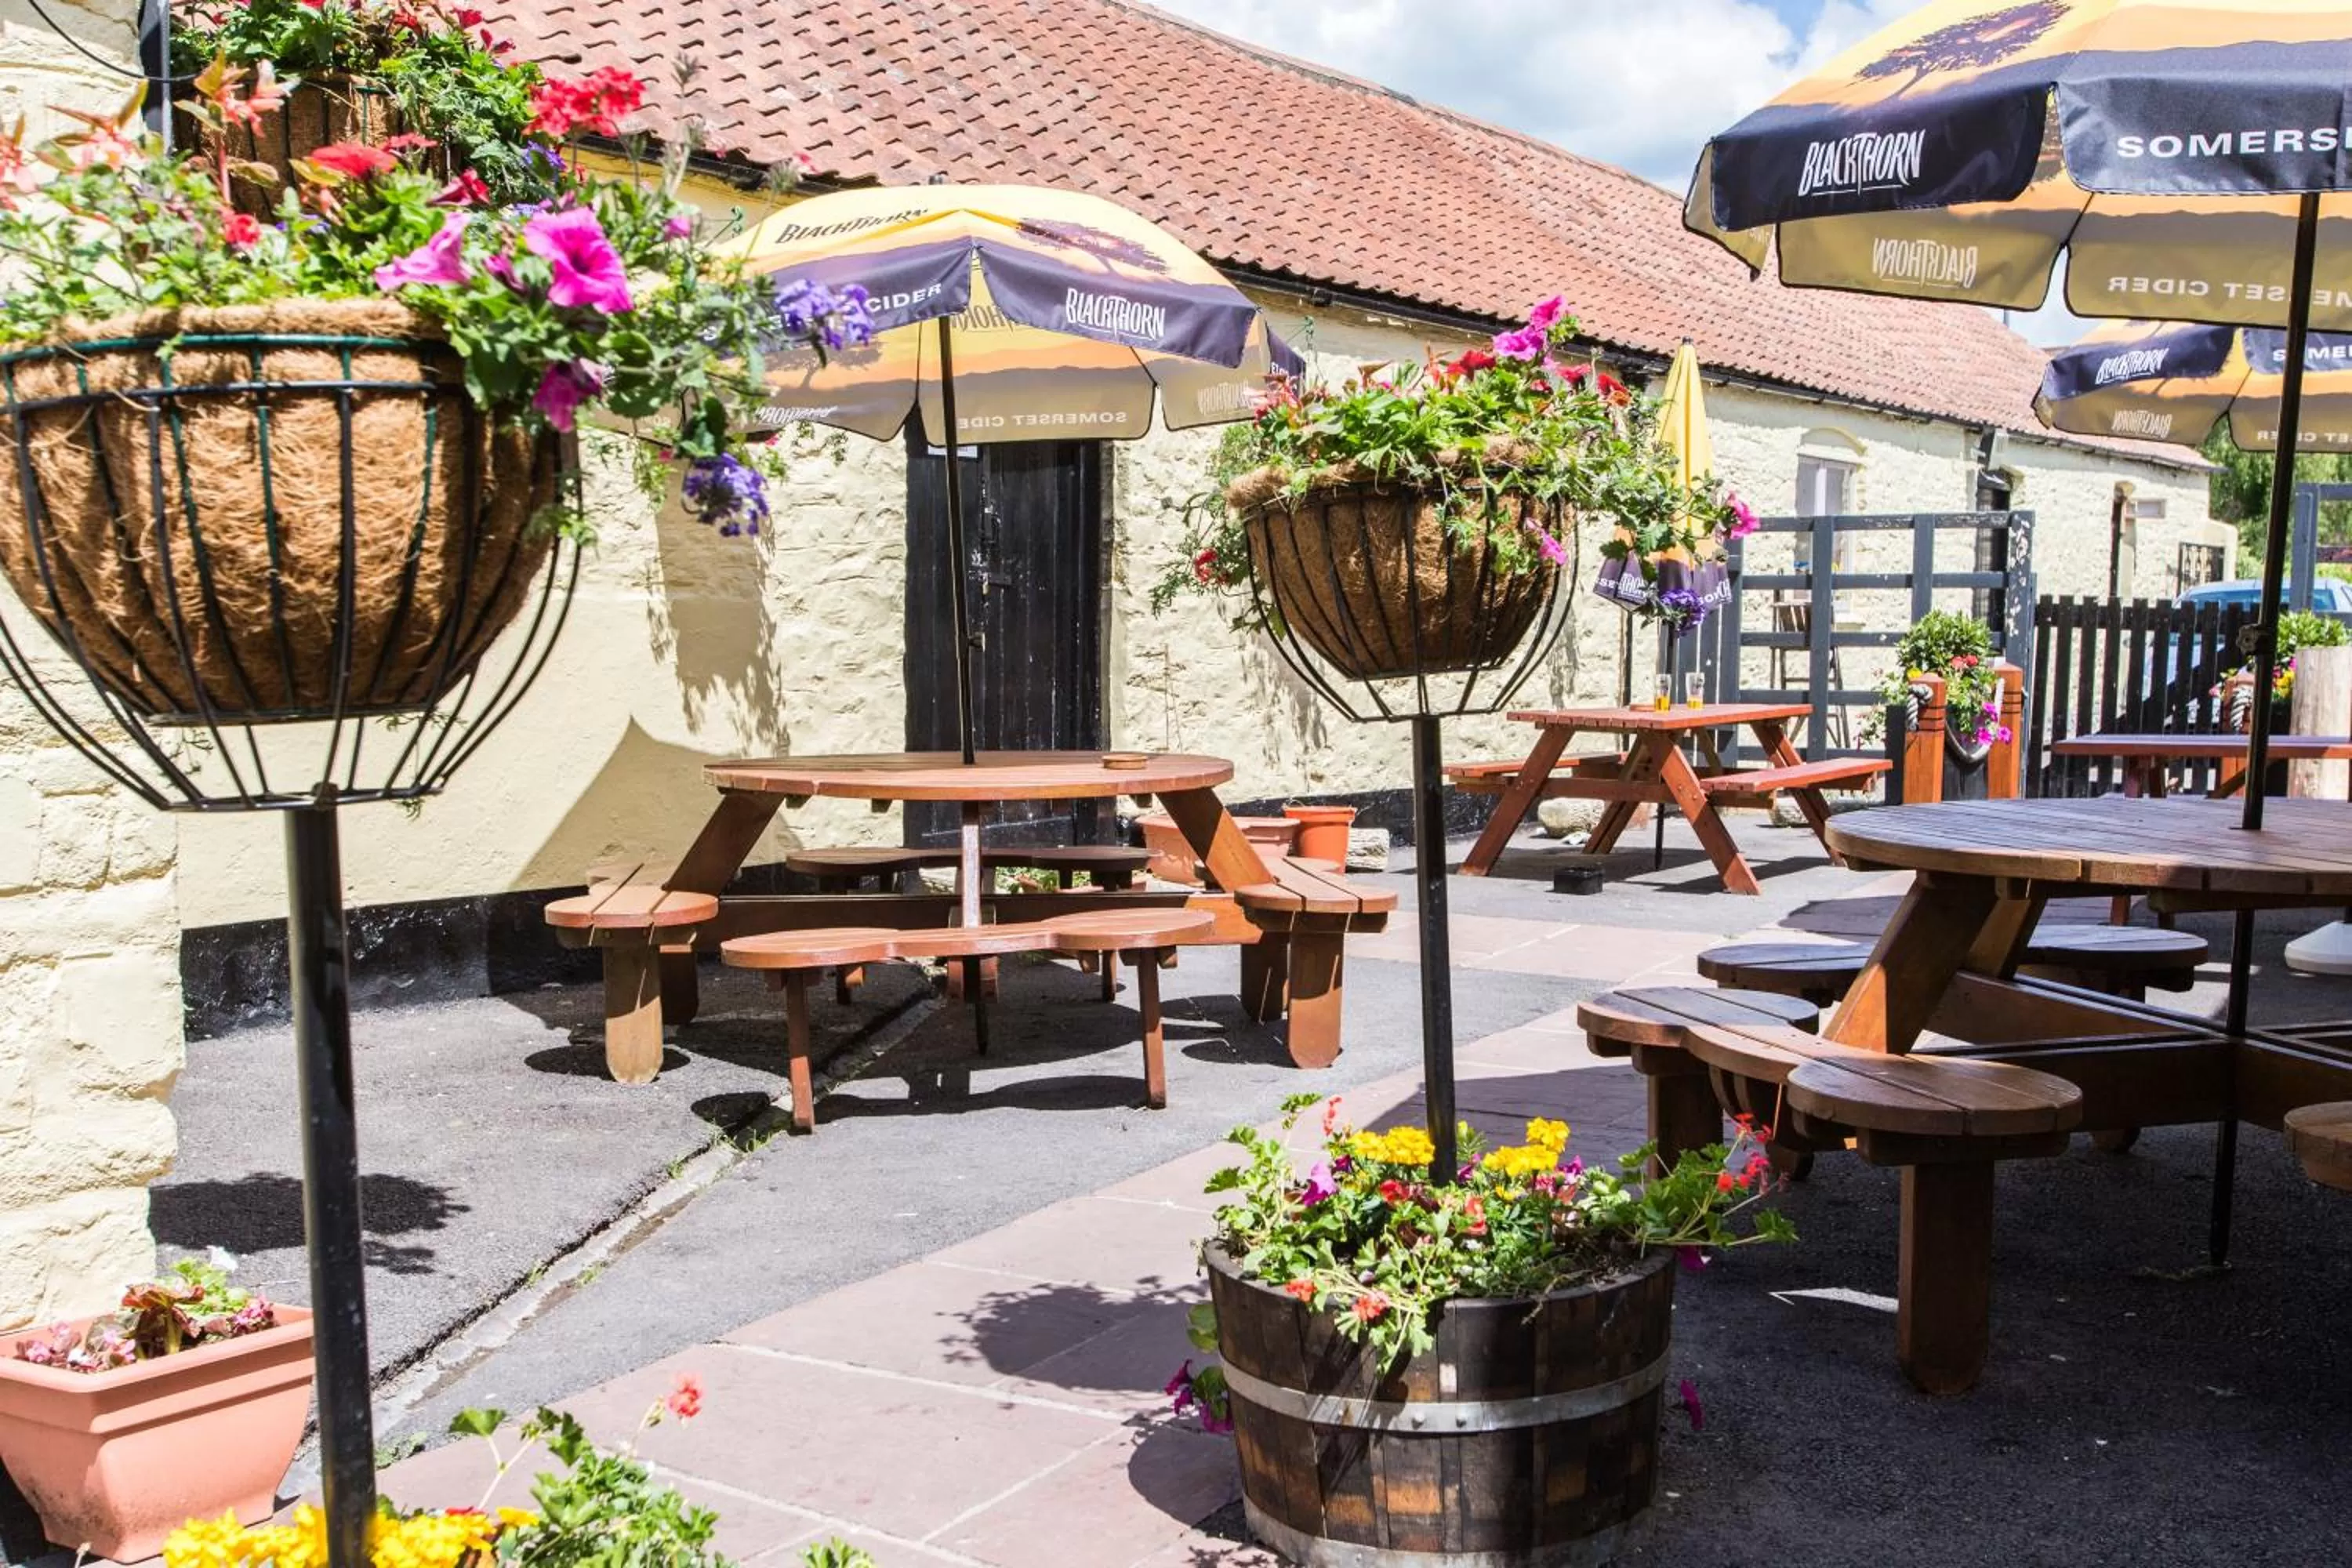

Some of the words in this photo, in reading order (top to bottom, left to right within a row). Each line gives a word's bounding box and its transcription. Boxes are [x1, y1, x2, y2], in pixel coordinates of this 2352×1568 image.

[2117, 127, 2352, 158] SOMERS
[1798, 129, 1926, 196] BLACKTHORN
[866, 282, 942, 313] CIDER
[1065, 287, 1167, 340] BLACKTHORN
[2094, 347, 2170, 385] BLACKTHORN
